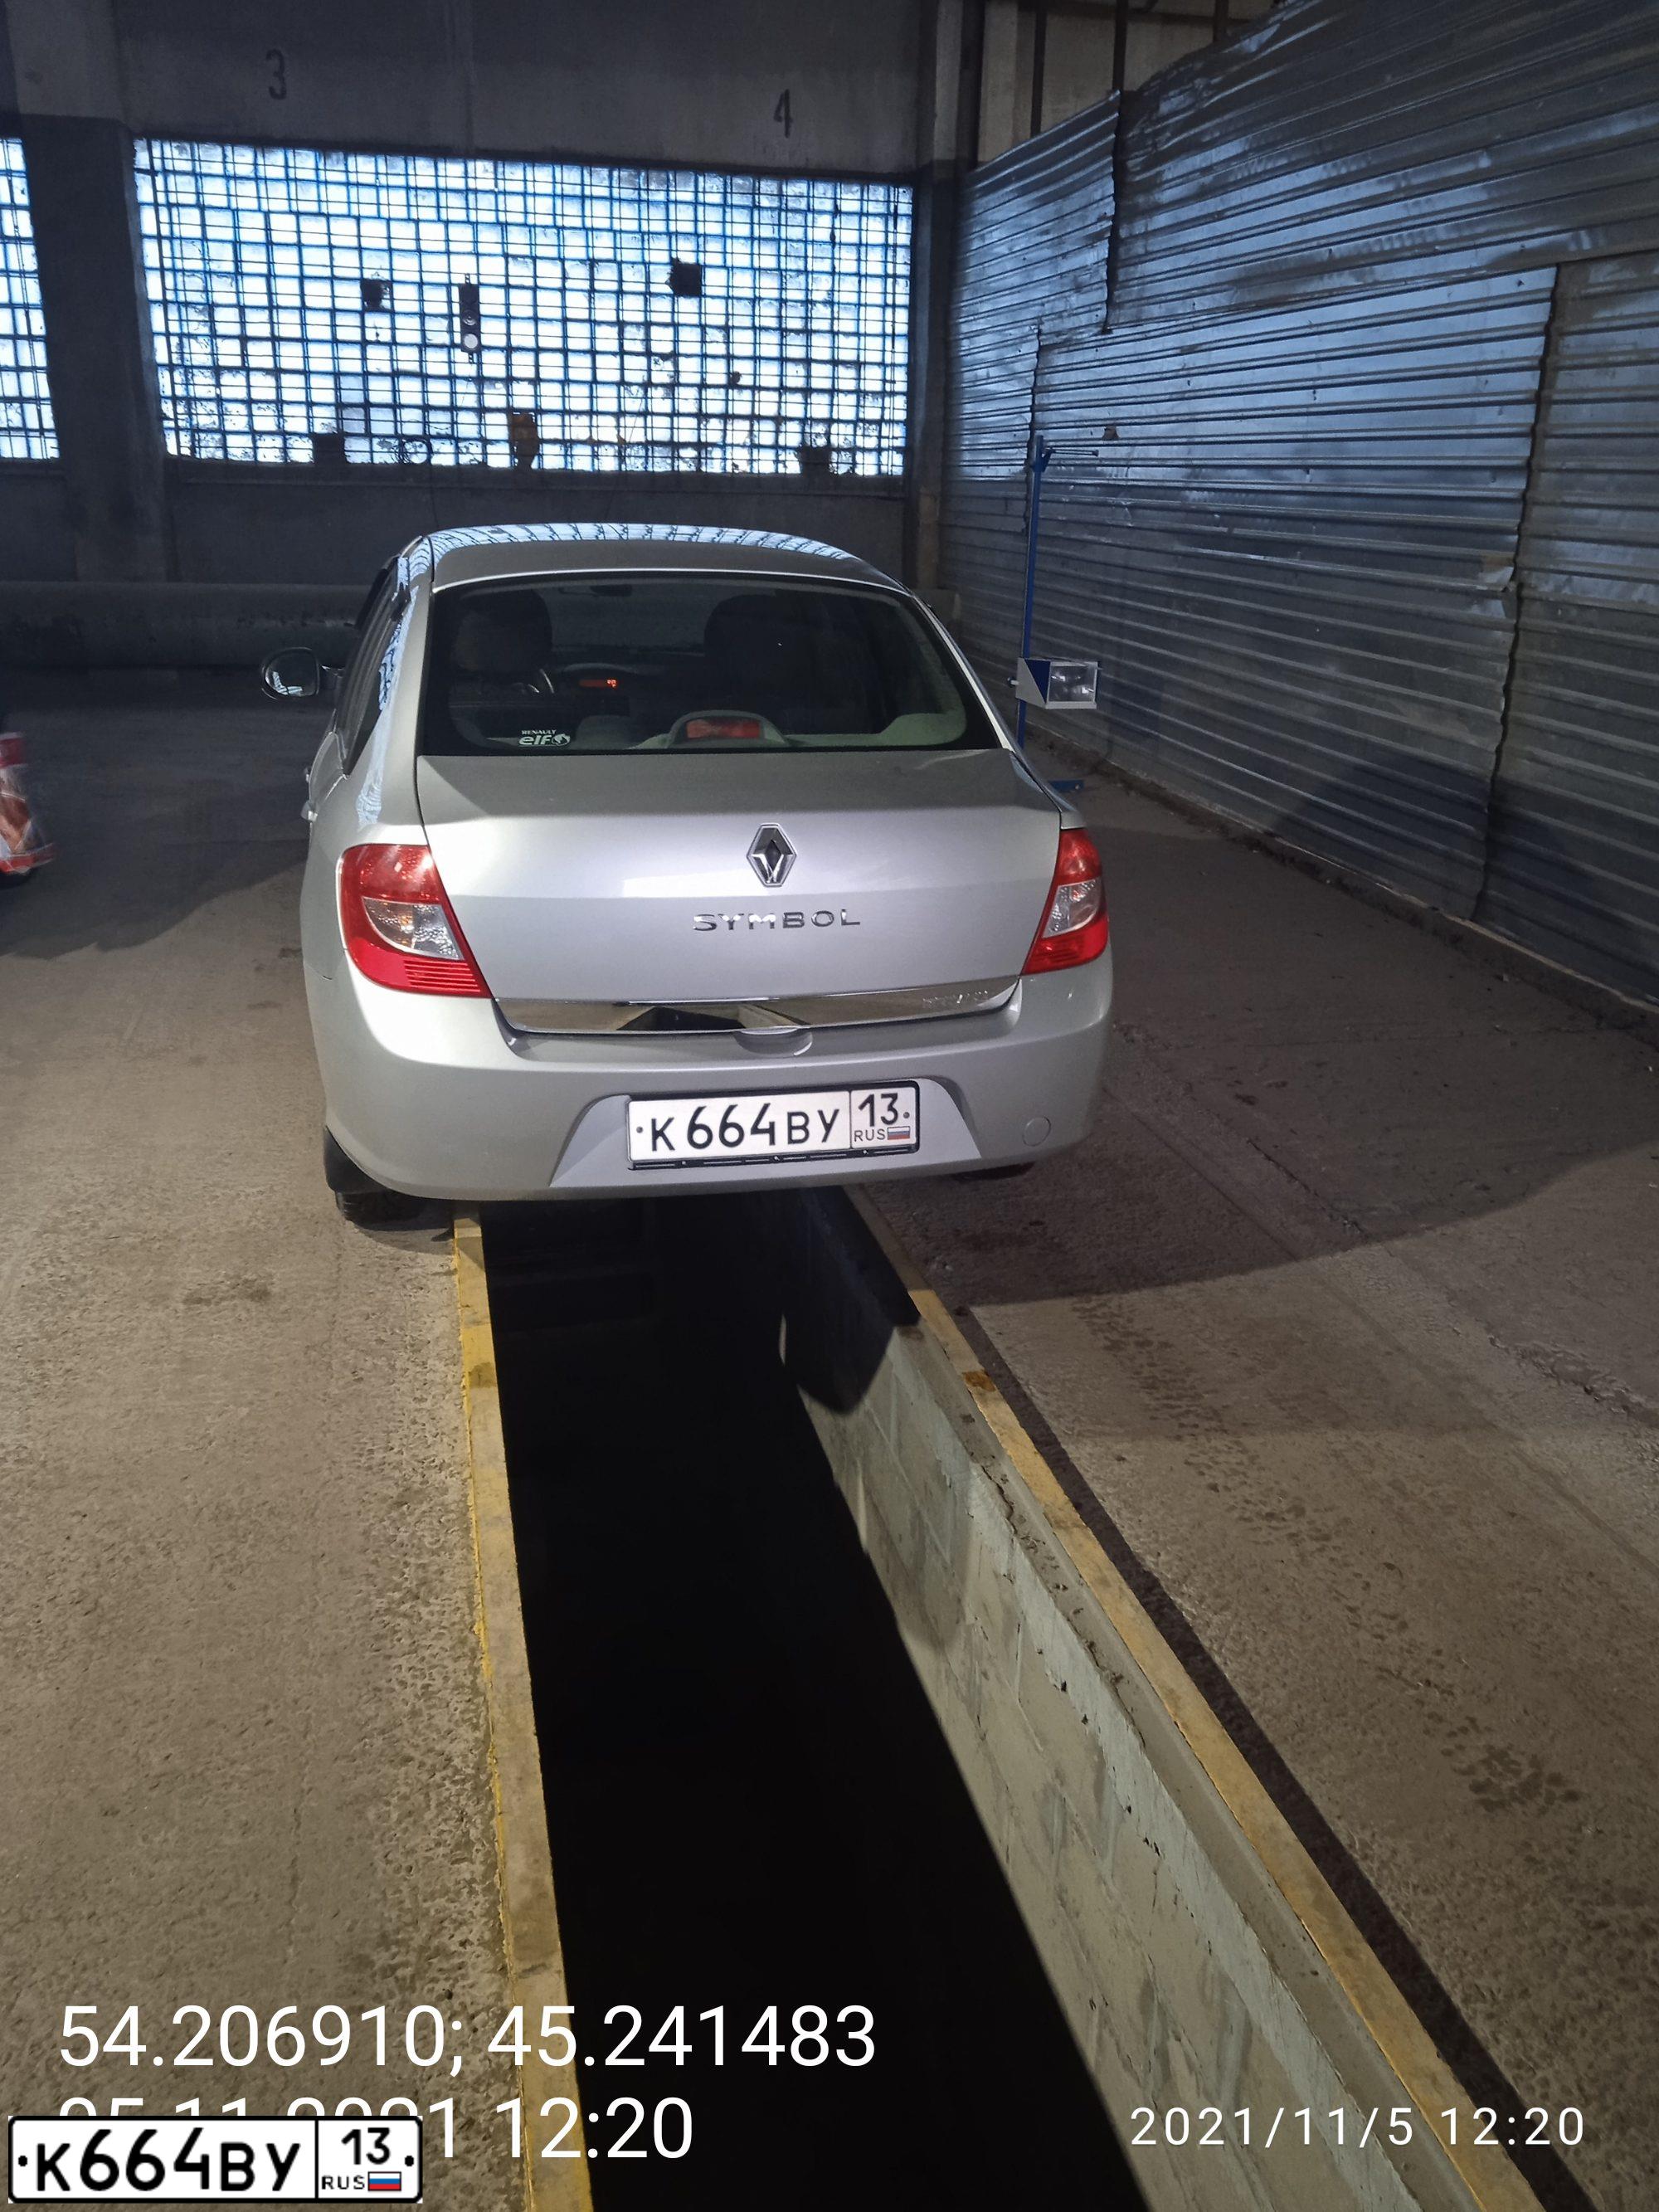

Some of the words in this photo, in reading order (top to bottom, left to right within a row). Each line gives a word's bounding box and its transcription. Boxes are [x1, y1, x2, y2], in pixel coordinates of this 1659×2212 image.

[265, 49, 287, 100] 3
[773, 89, 794, 139] 4
[693, 909, 861, 932] SYMBOL
[858, 1092, 899, 1127] 13
[854, 1130, 886, 1142] RUS
